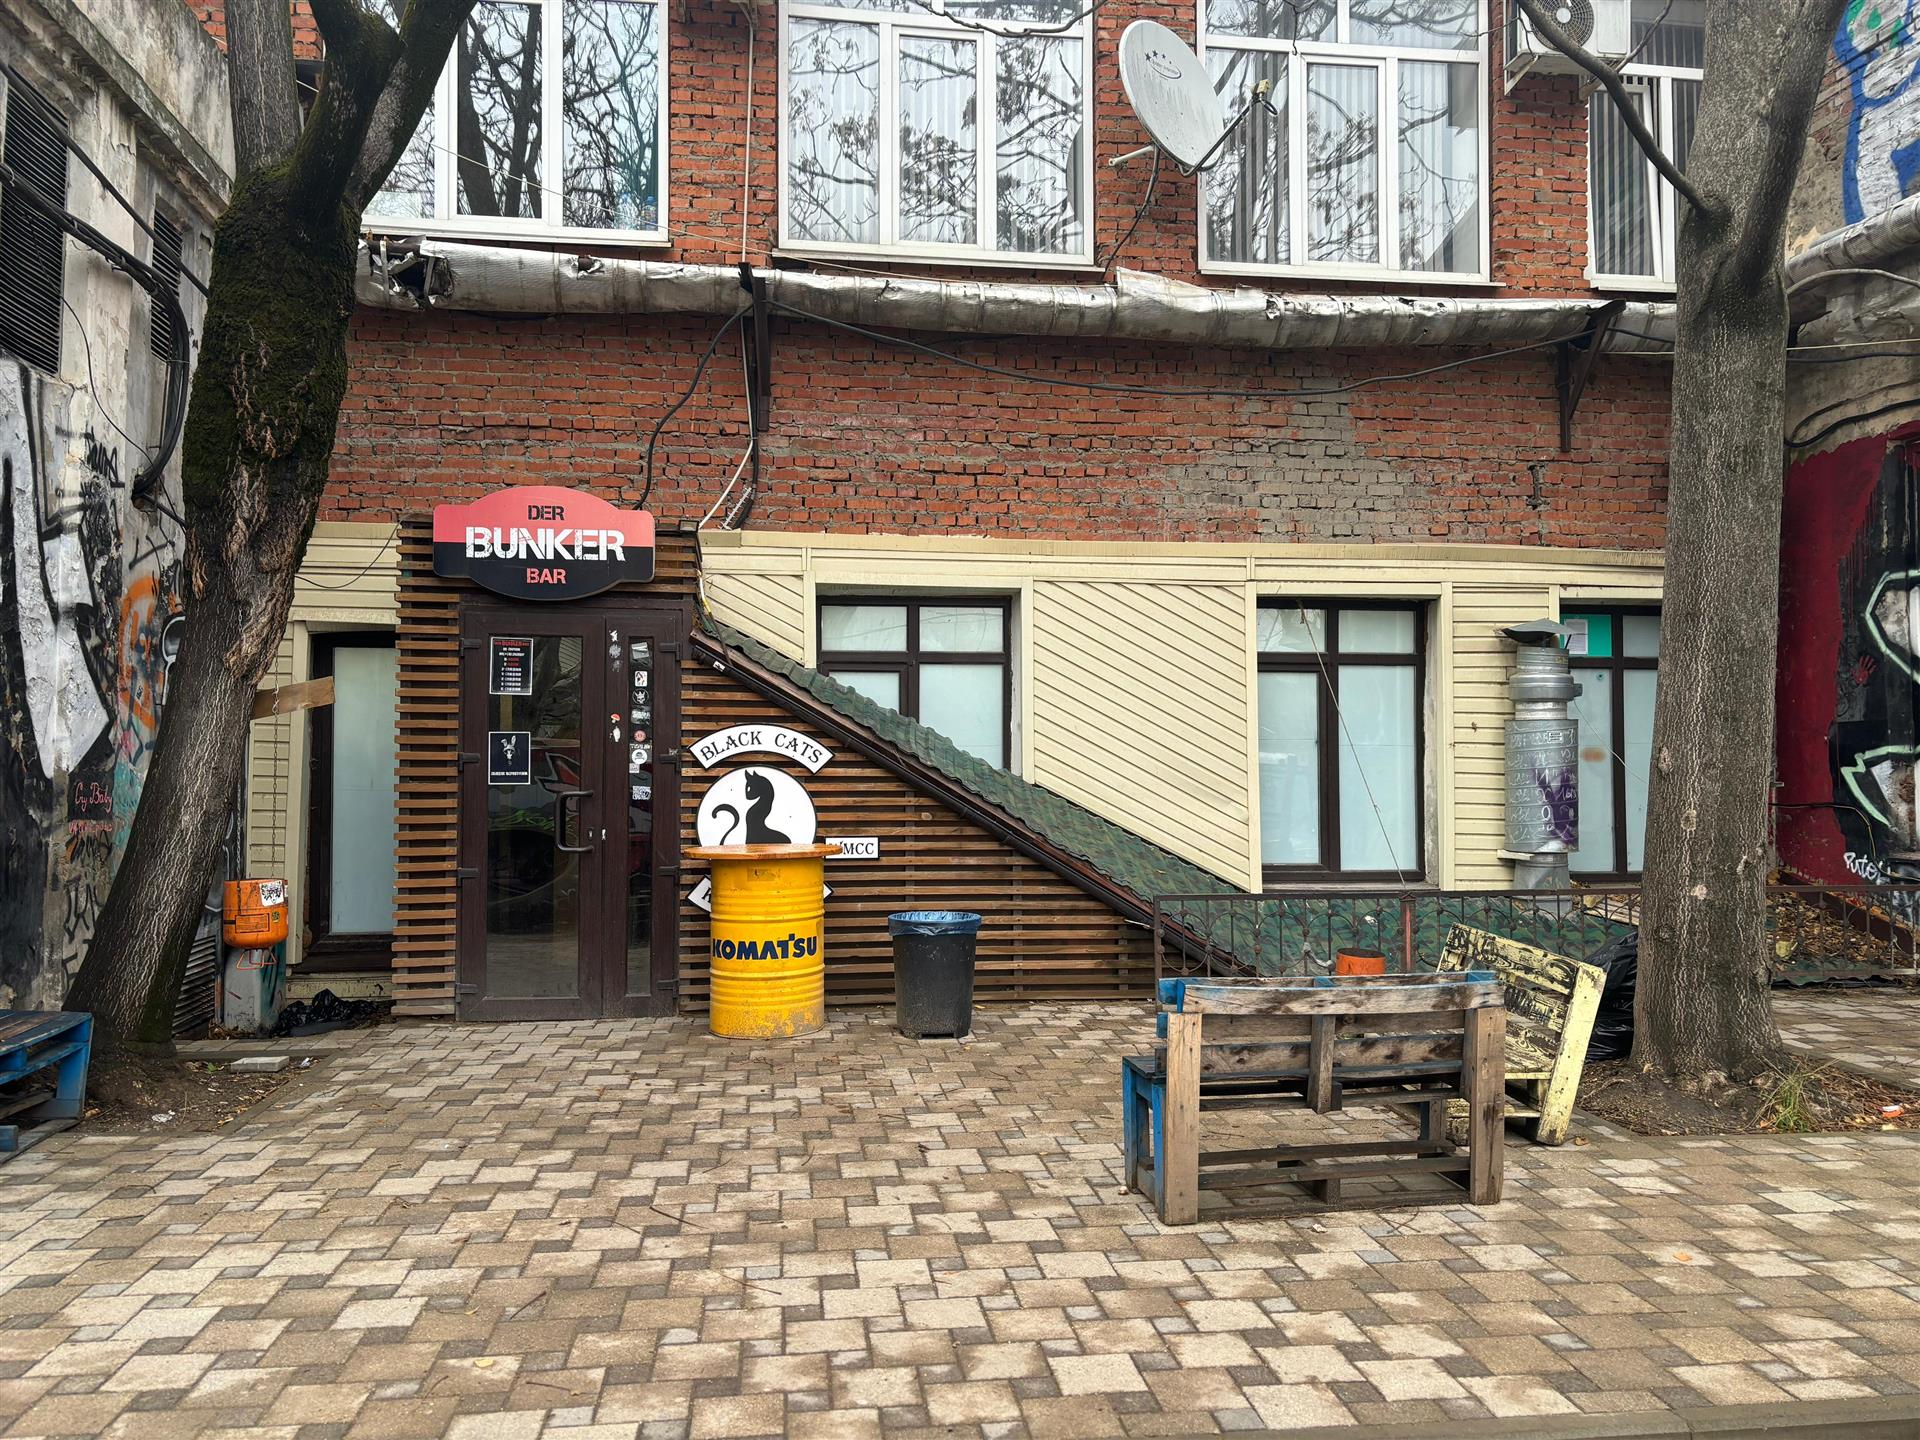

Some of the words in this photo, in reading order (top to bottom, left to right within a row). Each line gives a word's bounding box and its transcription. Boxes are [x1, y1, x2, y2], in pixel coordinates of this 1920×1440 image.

[528, 505, 564, 521] DER
[465, 526, 626, 562] BUNKER
[526, 567, 567, 584] BAR
[700, 730, 762, 761] BLACK
[774, 733, 823, 764] CATS
[830, 842, 875, 855] MCC
[712, 933, 817, 960] KOMATSU
